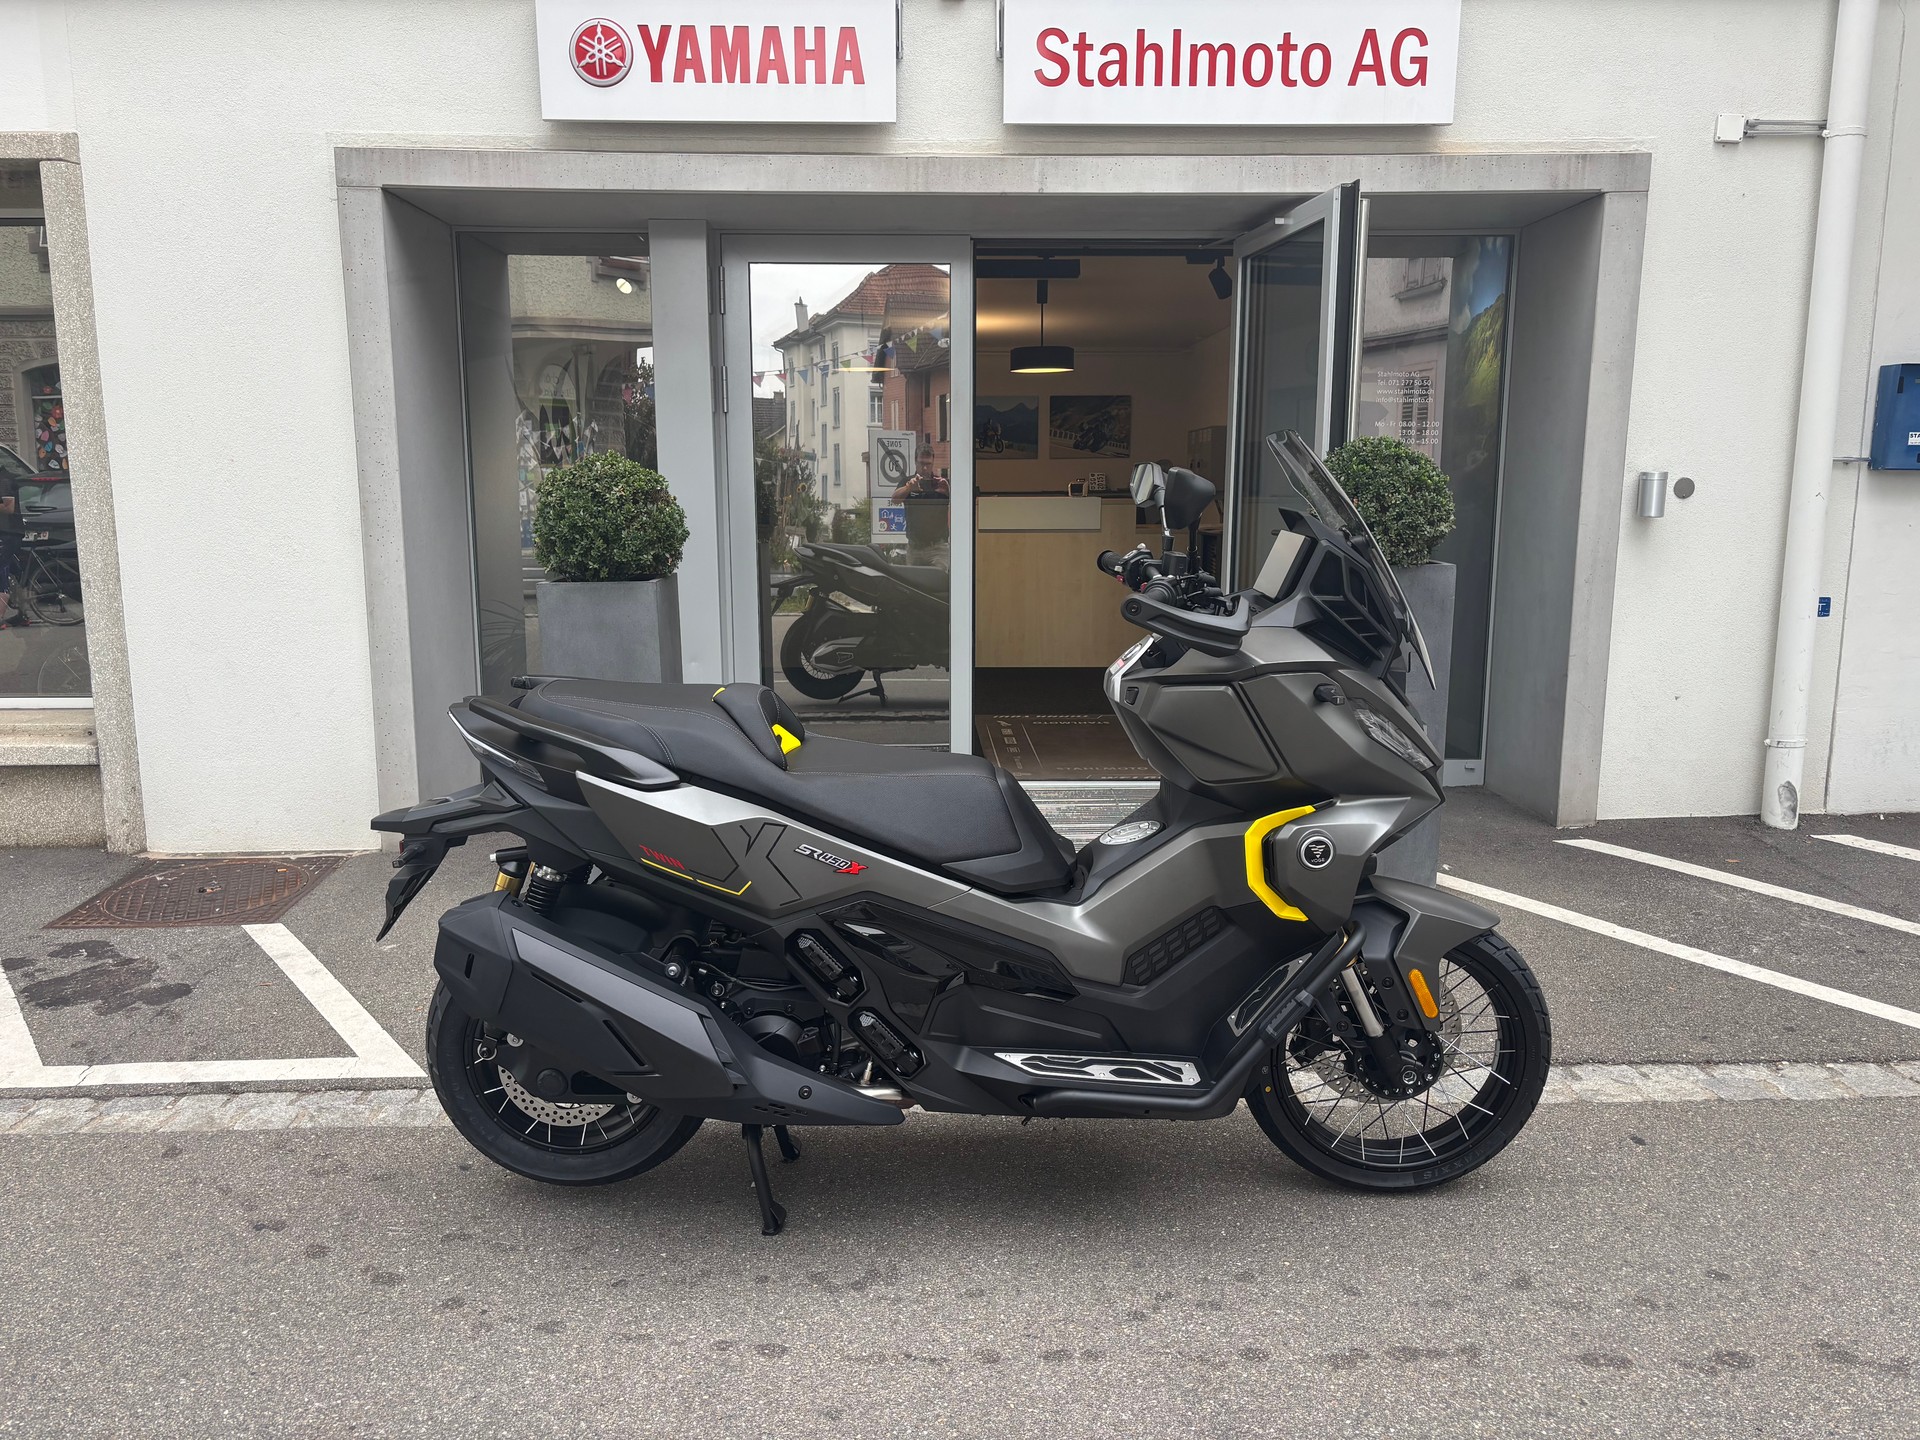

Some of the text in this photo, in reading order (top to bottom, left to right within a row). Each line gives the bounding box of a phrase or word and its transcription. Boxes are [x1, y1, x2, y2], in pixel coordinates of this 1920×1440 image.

[636, 24, 866, 85] YAMAHA
[1034, 27, 1429, 87] Stahlmoto AG
[1377, 370, 1409, 378] Stahlmoto
[639, 844, 686, 870] TWIN
